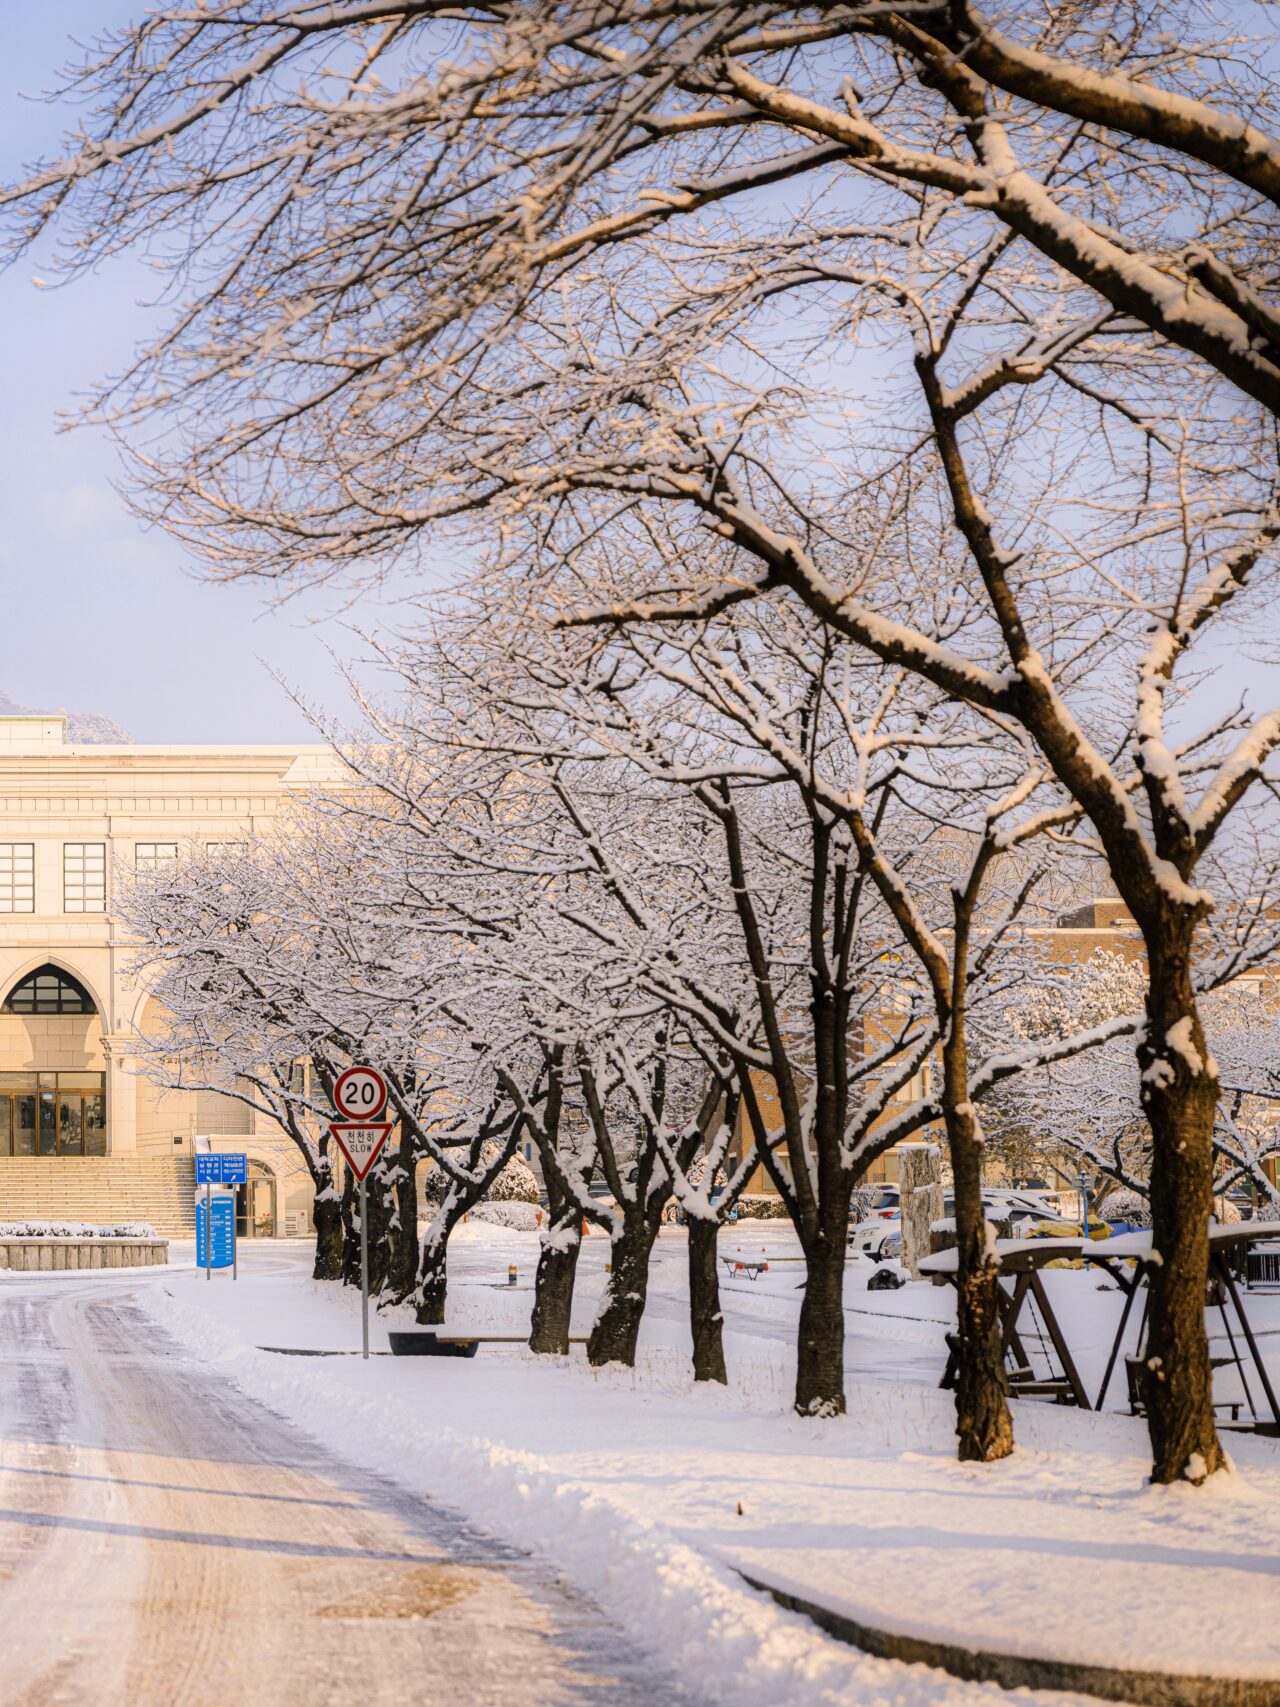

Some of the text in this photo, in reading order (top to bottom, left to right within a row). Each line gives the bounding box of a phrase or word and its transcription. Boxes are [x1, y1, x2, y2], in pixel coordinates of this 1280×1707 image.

[345, 1082, 375, 1105] 20
[347, 1130, 375, 1143] 천천히
[349, 1144, 372, 1153] SLOW
